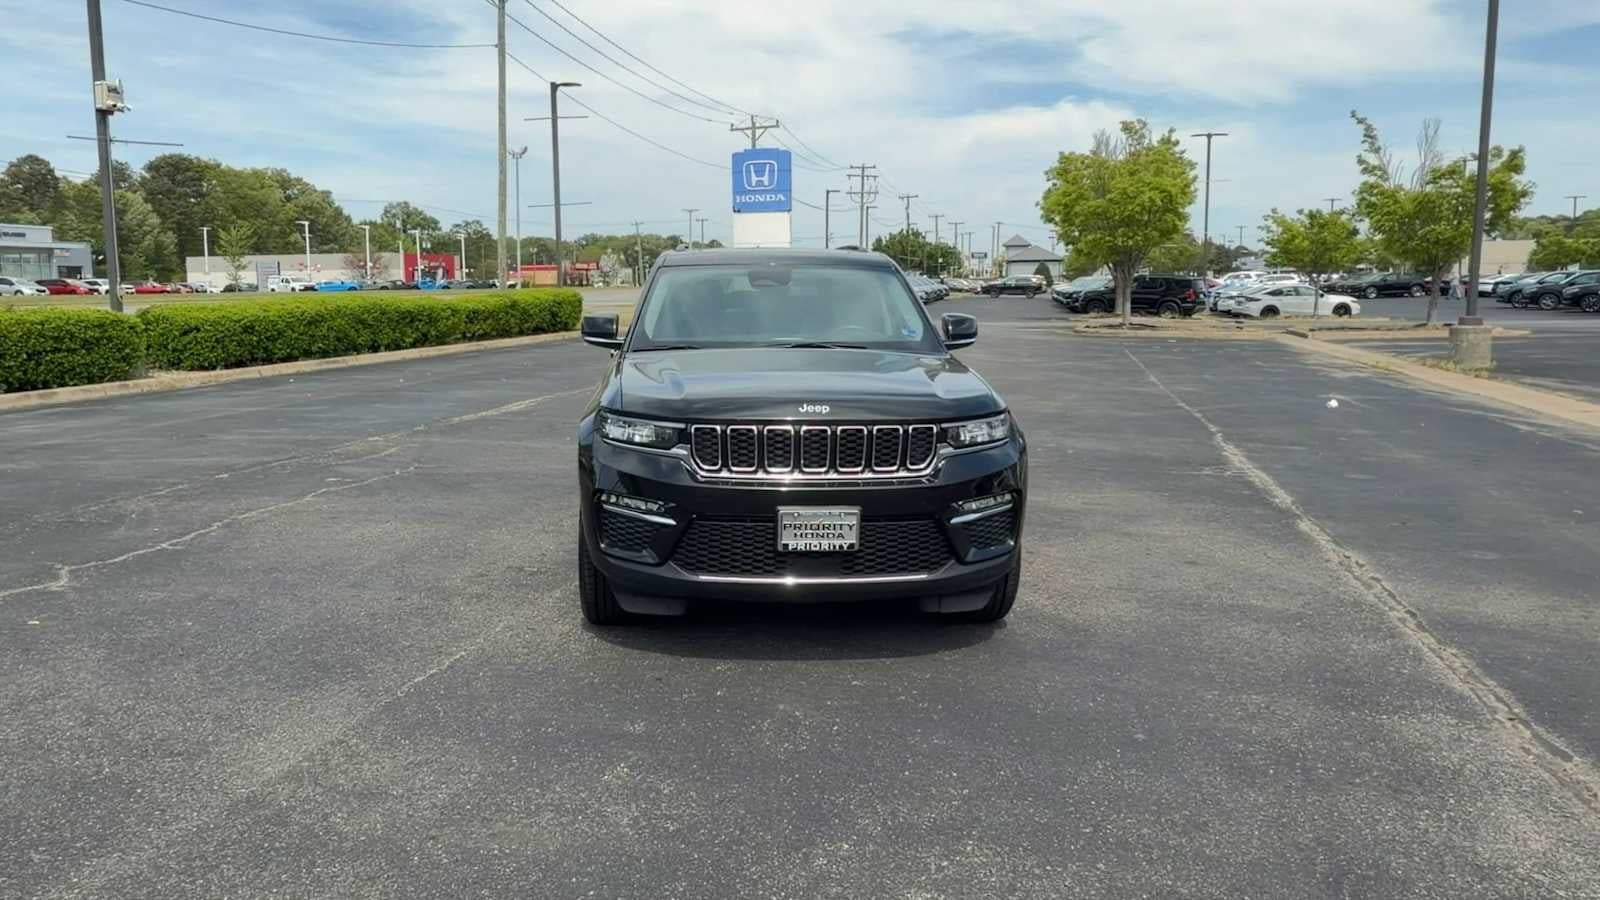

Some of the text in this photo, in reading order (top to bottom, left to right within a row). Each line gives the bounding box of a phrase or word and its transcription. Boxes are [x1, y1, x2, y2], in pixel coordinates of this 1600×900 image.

[736, 194, 785, 203] HONDA
[798, 403, 830, 414] Jeep
[783, 523, 855, 531] PRIORITY
[788, 543, 849, 551] PRIORITY
